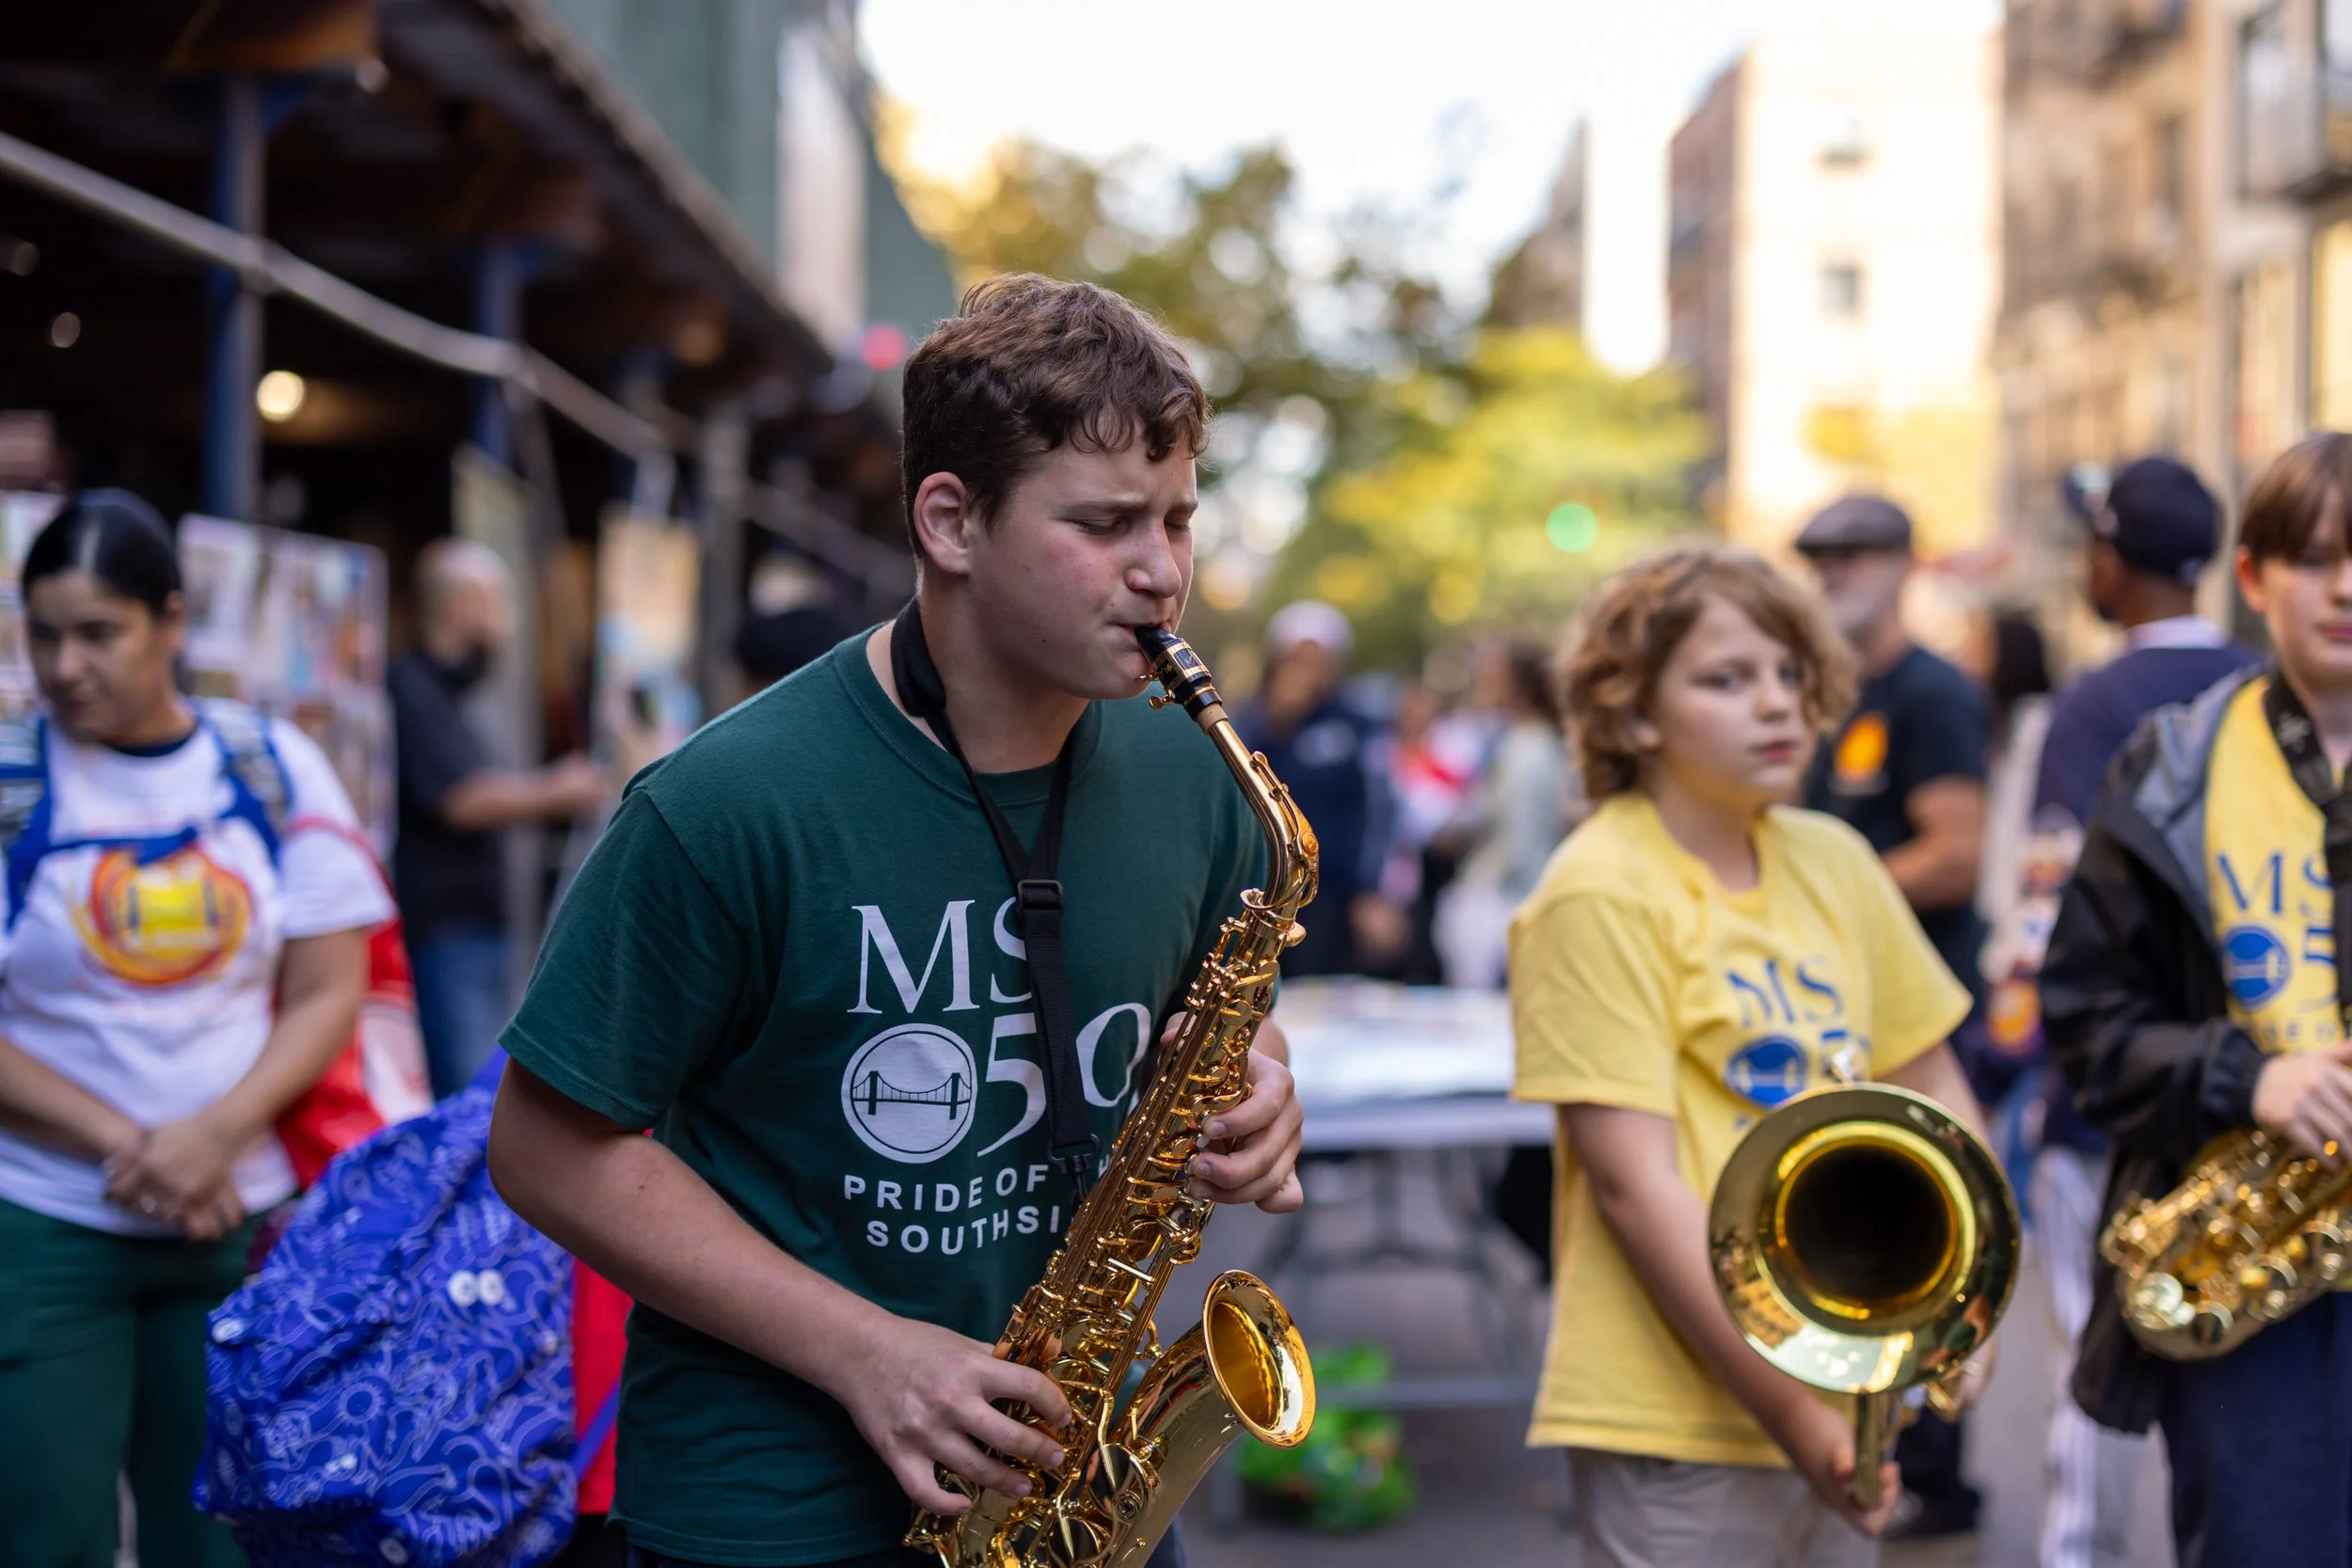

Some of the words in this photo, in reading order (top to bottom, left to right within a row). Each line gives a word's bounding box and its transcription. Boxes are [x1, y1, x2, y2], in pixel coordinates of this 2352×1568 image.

[1726, 957, 1845, 1026] MS
[977, 1003, 1152, 1158] 50
[844, 1174, 982, 1212] PRIDE
[995, 1164, 1049, 1196] OF
[866, 1205, 1060, 1255] SOUTHSI
